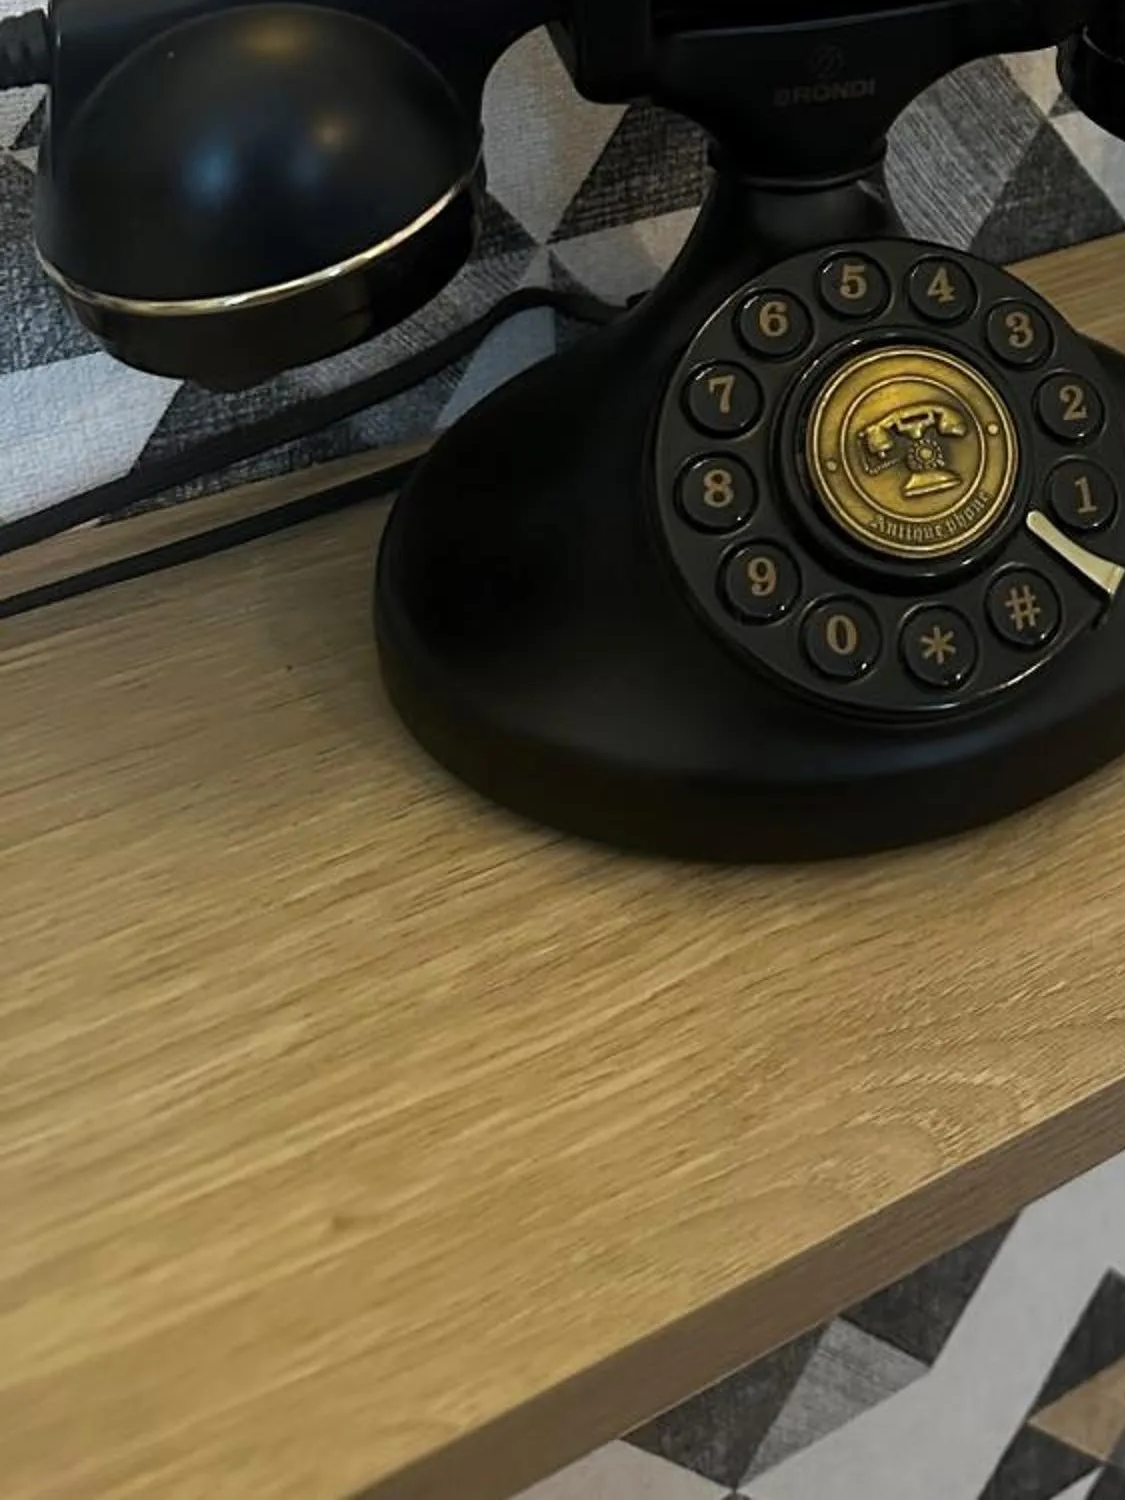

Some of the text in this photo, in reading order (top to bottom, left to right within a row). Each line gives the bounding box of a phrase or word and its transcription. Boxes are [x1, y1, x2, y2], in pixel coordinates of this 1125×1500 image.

[773, 76, 877, 107] BRONDI
[839, 265, 867, 299] 5
[927, 268, 955, 303] 4
[758, 302, 789, 337] 6
[1006, 312, 1034, 349] 3
[708, 375, 736, 414] 7
[1059, 384, 1087, 422] 2
[703, 470, 733, 508] 8
[1074, 477, 1096, 514] 1
[746, 557, 777, 597] 9
[1006, 585, 1041, 630] #
[826, 614, 857, 655] 0
